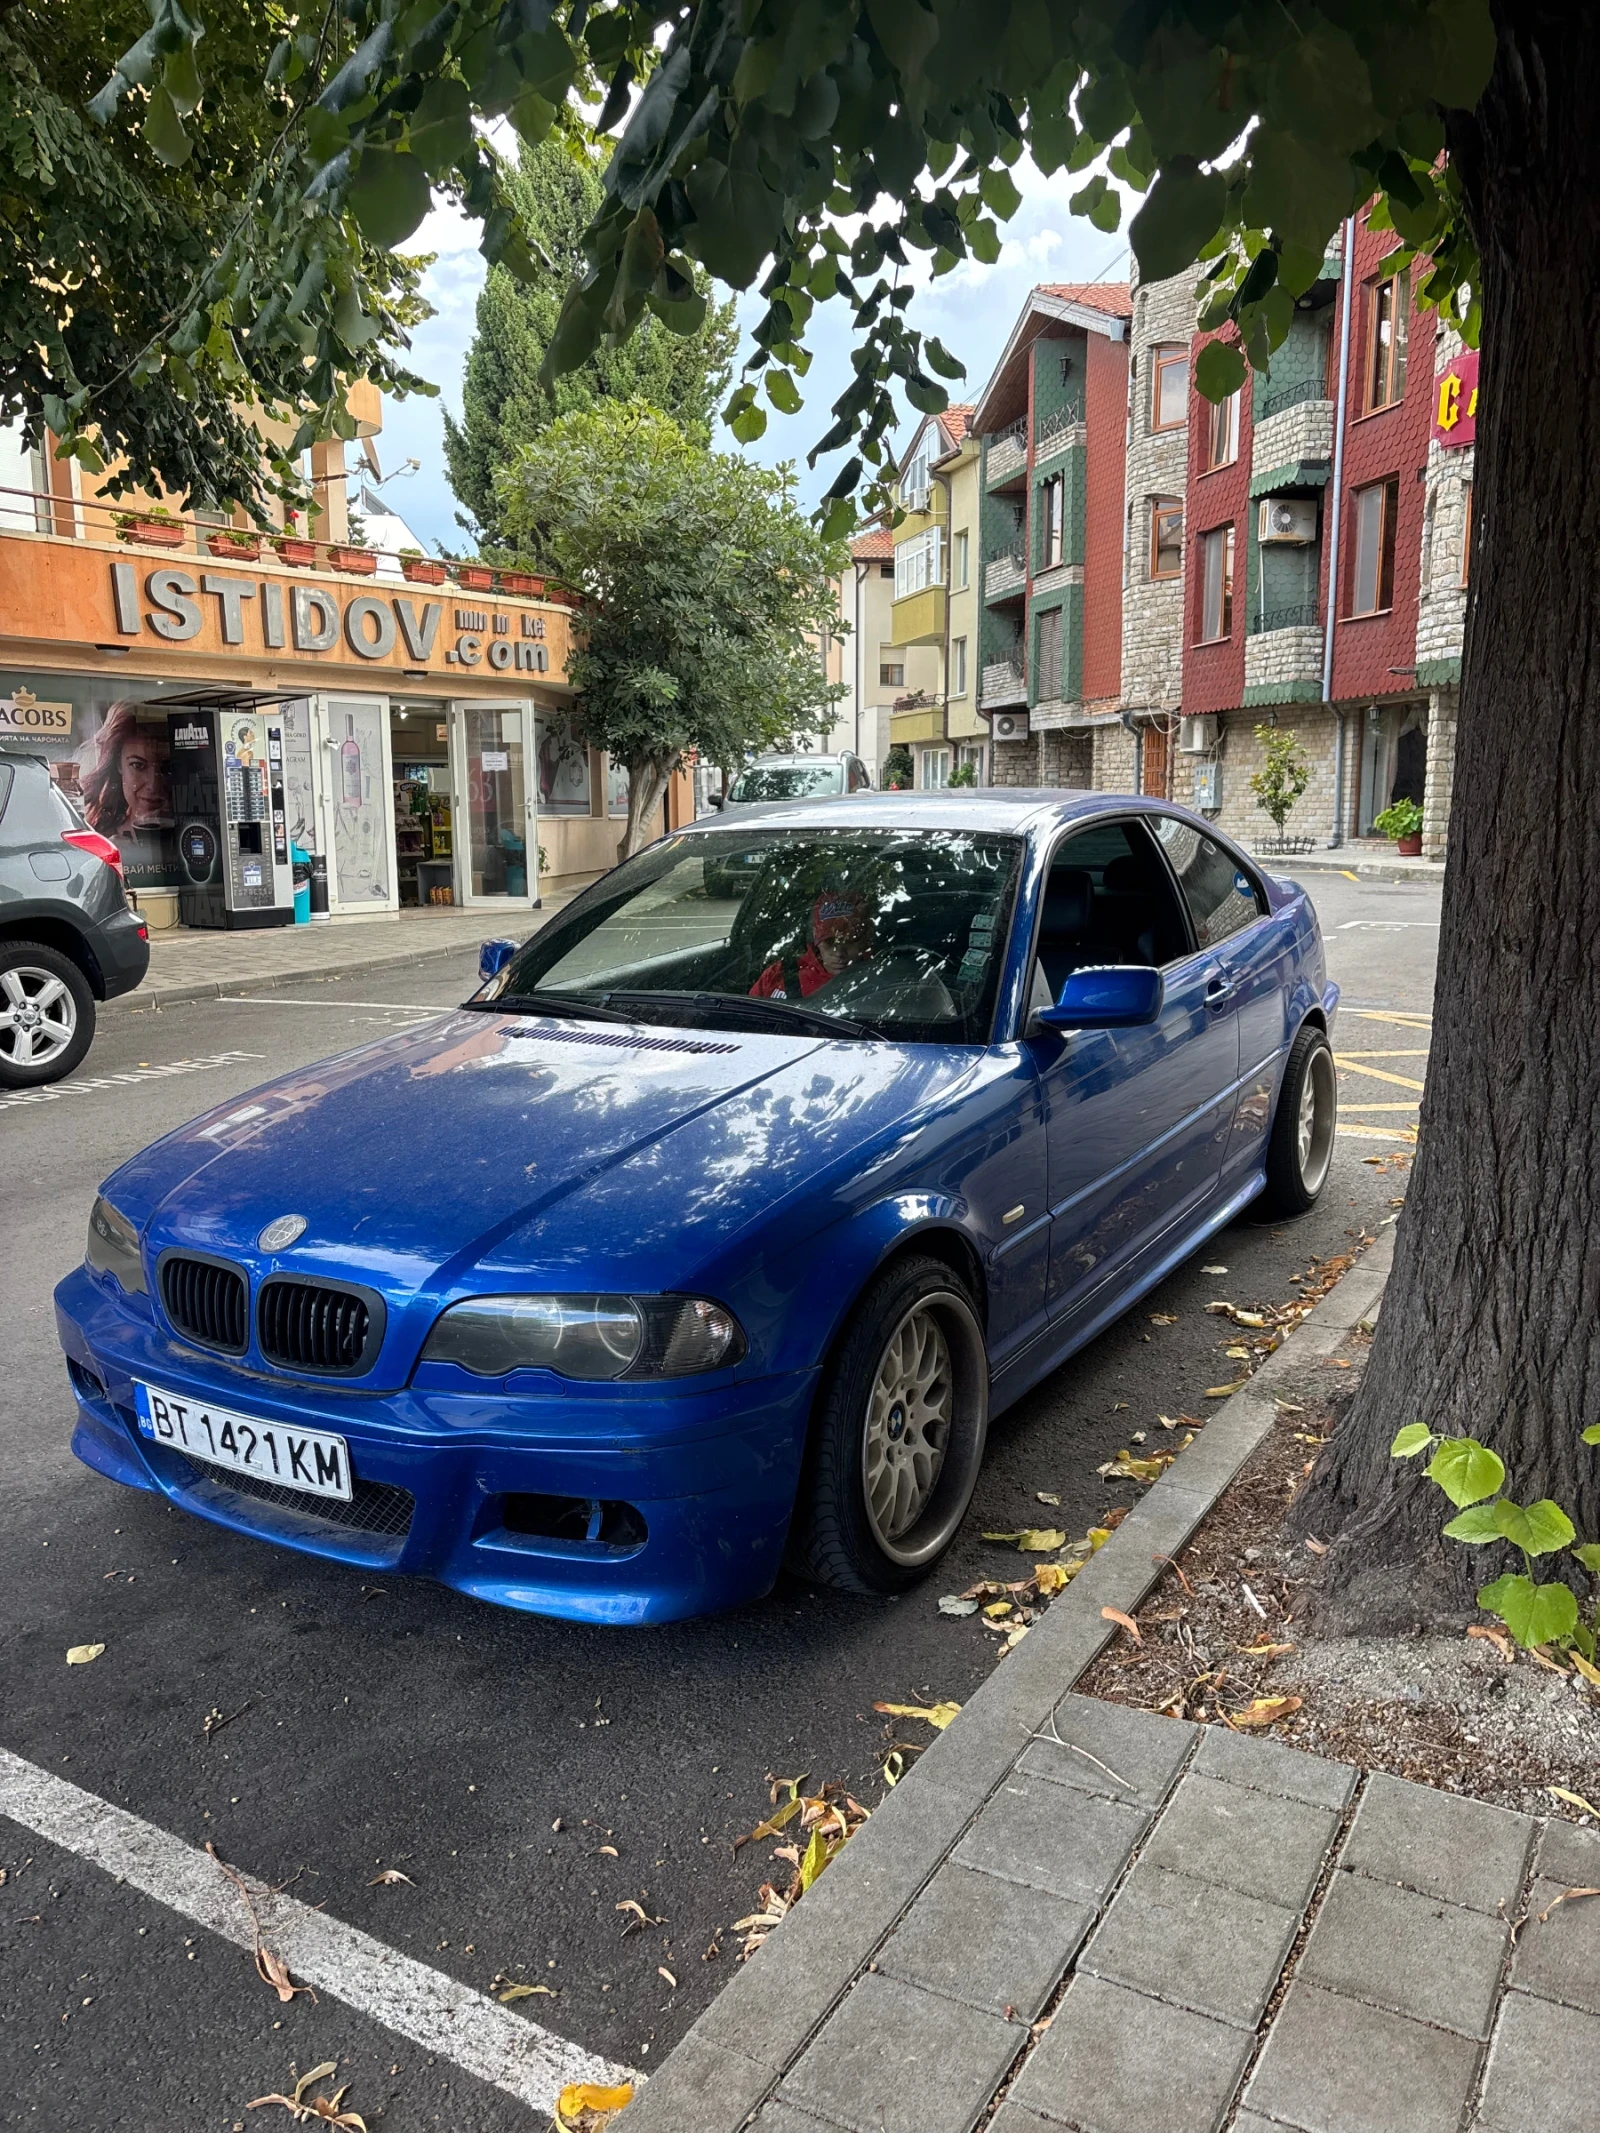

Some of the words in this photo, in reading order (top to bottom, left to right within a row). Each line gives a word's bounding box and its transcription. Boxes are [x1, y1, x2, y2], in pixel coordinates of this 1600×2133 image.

[110, 562, 443, 661] ISTIDOV
[445, 634, 549, 672] .com
[175, 722, 209, 741] LAVAZZA
[140, 1416, 153, 1431] BG
[151, 1395, 190, 1447] BT
[200, 1414, 281, 1475] 1421
[287, 1435, 343, 1490] KM
